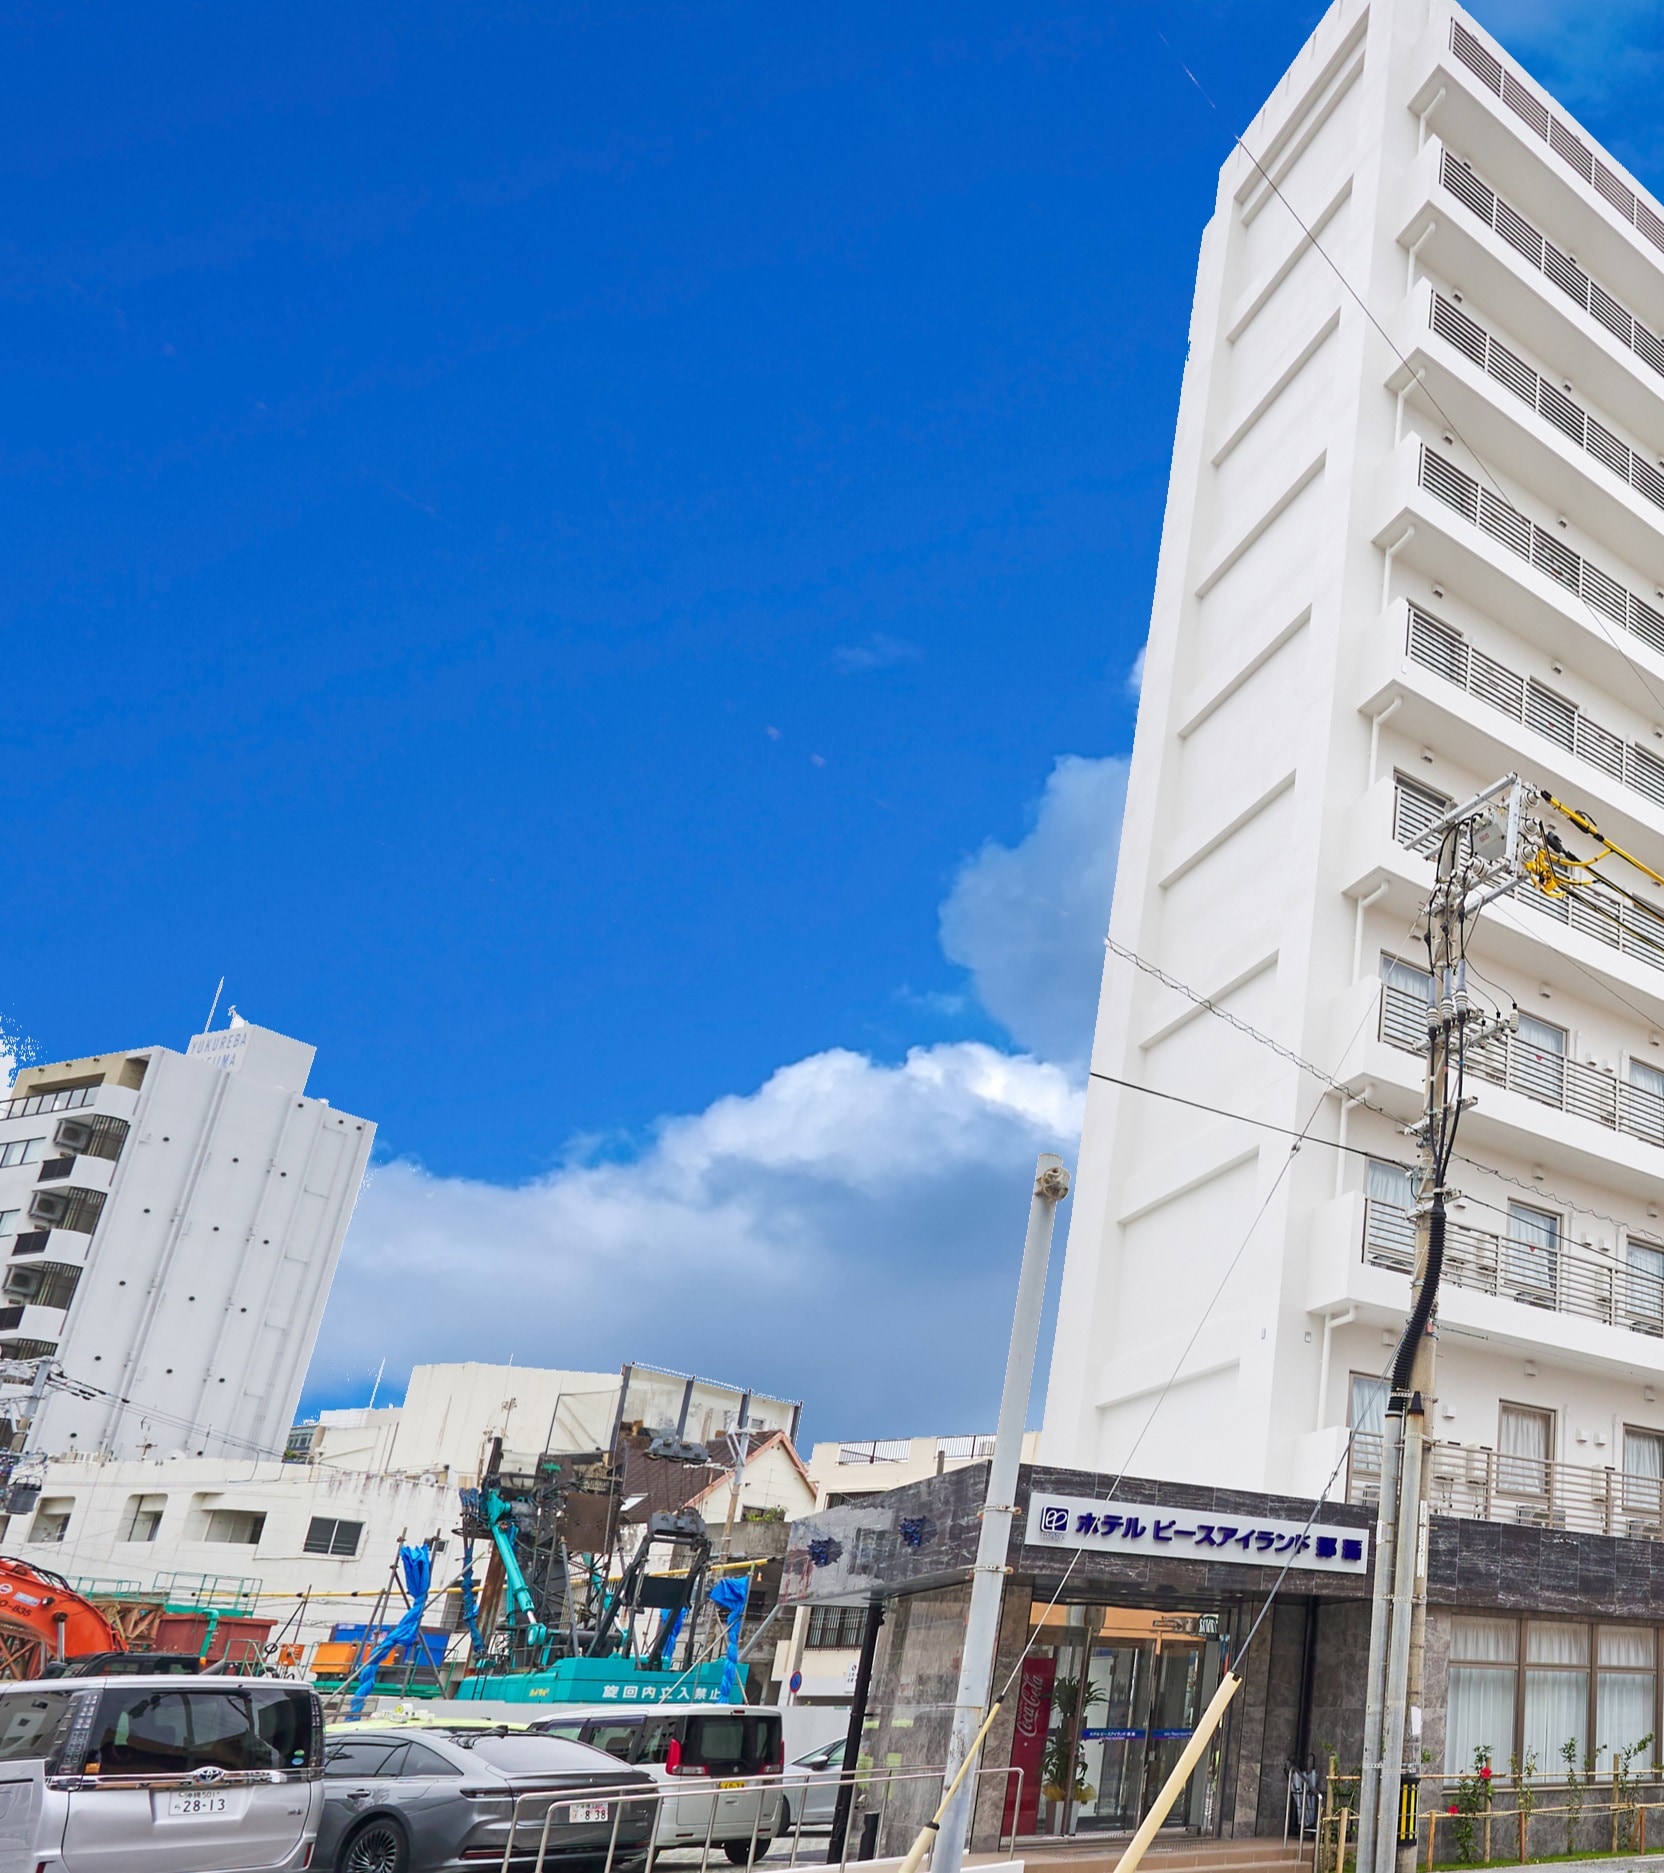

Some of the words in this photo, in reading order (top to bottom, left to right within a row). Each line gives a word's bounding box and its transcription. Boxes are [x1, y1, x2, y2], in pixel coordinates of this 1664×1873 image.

[1076, 1512, 1146, 1539] ホテル
[183, 1798, 225, 1813] 28-13
